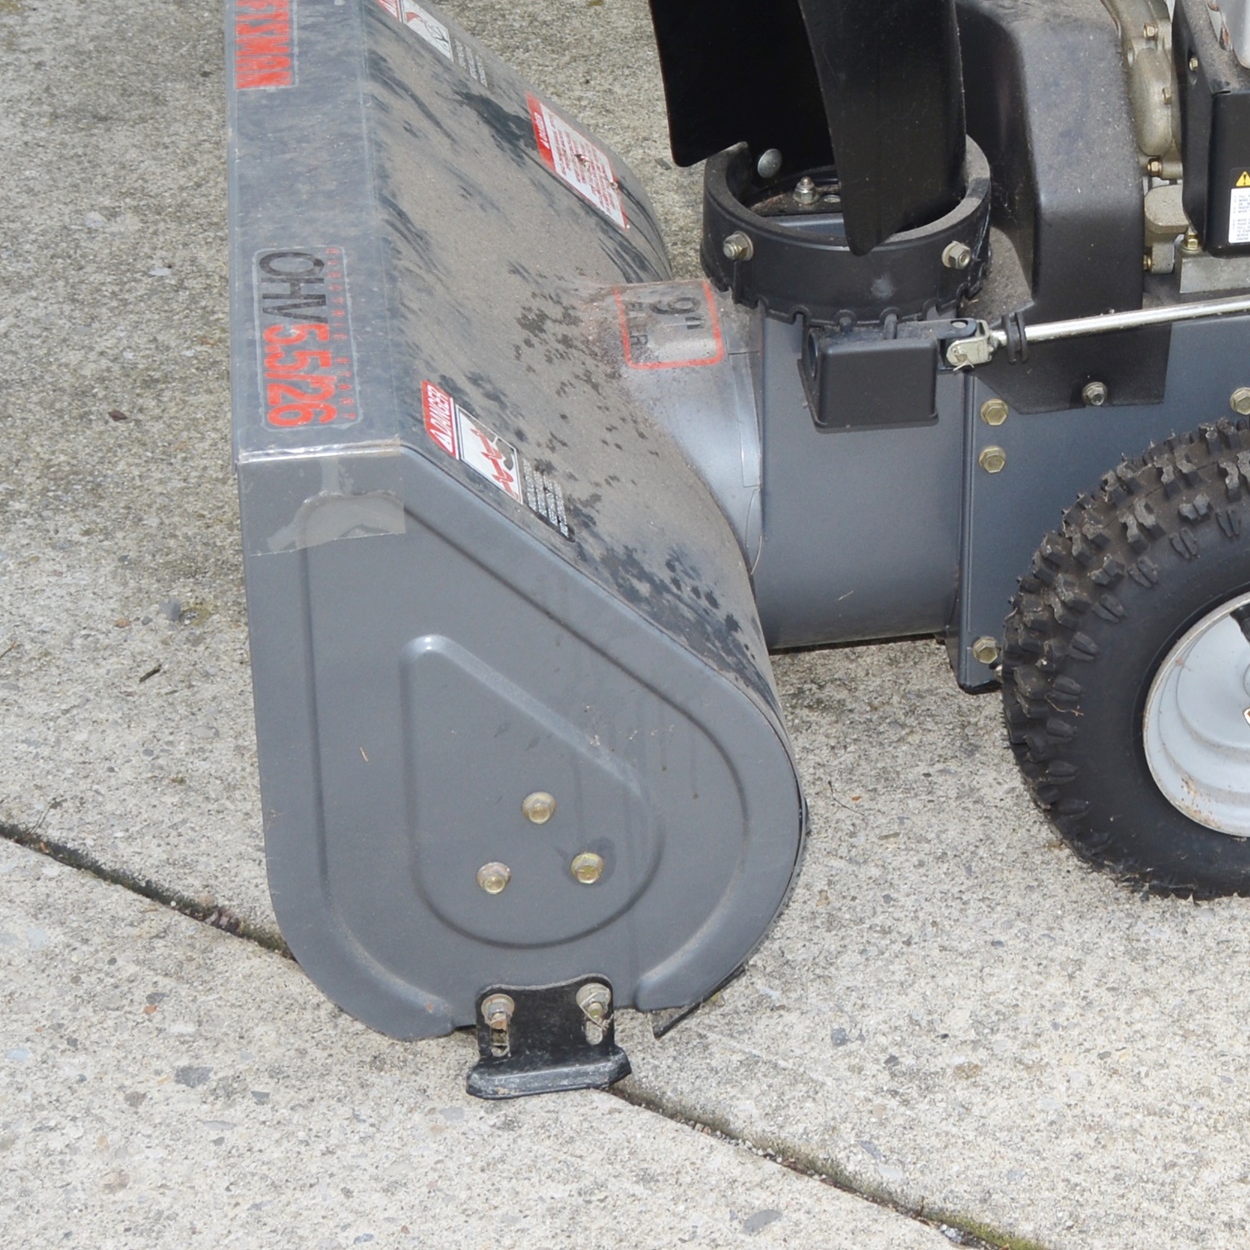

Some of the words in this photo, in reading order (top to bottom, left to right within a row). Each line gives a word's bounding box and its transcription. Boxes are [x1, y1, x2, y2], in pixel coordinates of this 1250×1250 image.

[259, 252, 328, 324] OHV
[263, 323, 338, 427] 5.5/26
[428, 385, 451, 437] DANGER
